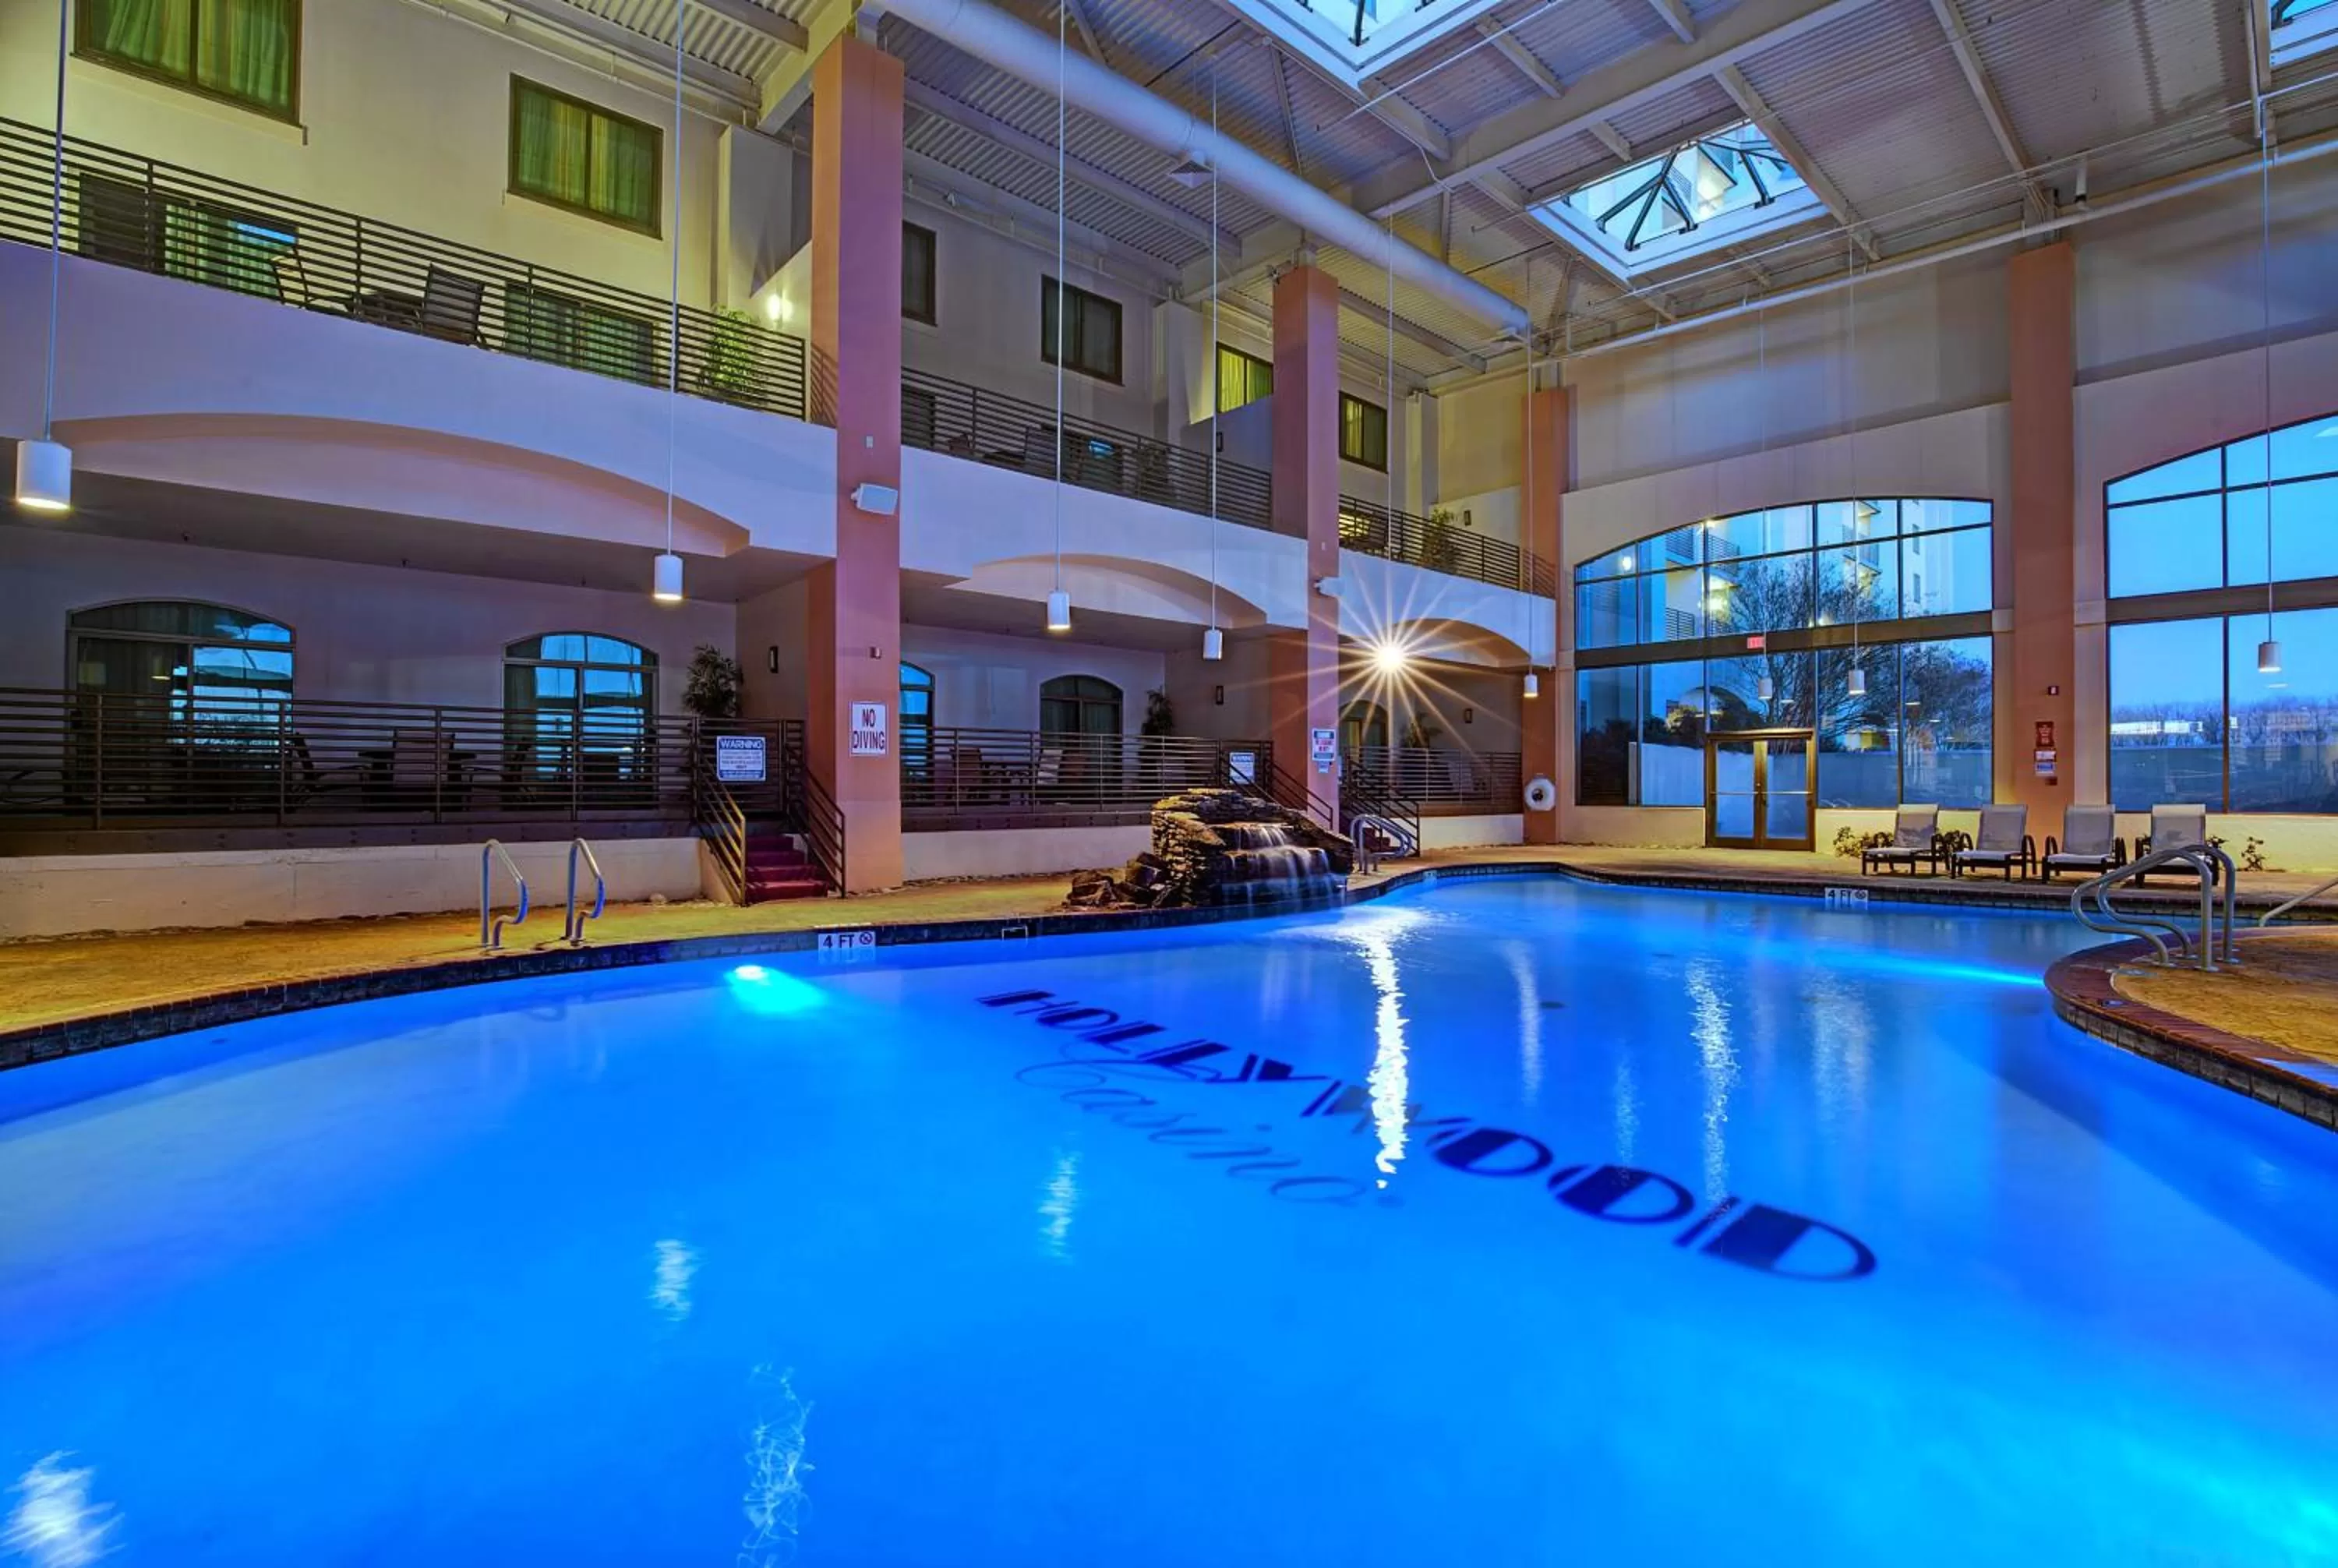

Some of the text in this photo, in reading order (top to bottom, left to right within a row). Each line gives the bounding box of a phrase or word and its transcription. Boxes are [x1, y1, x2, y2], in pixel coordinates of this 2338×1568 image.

[862, 708, 876, 727] NO
[719, 740, 762, 748] WARNING
[853, 730, 885, 750] DIVING
[823, 934, 854, 948] 4 FT
[1015, 1039, 1368, 1207] Casino
[976, 990, 1877, 1282] HOLLYWOOD
